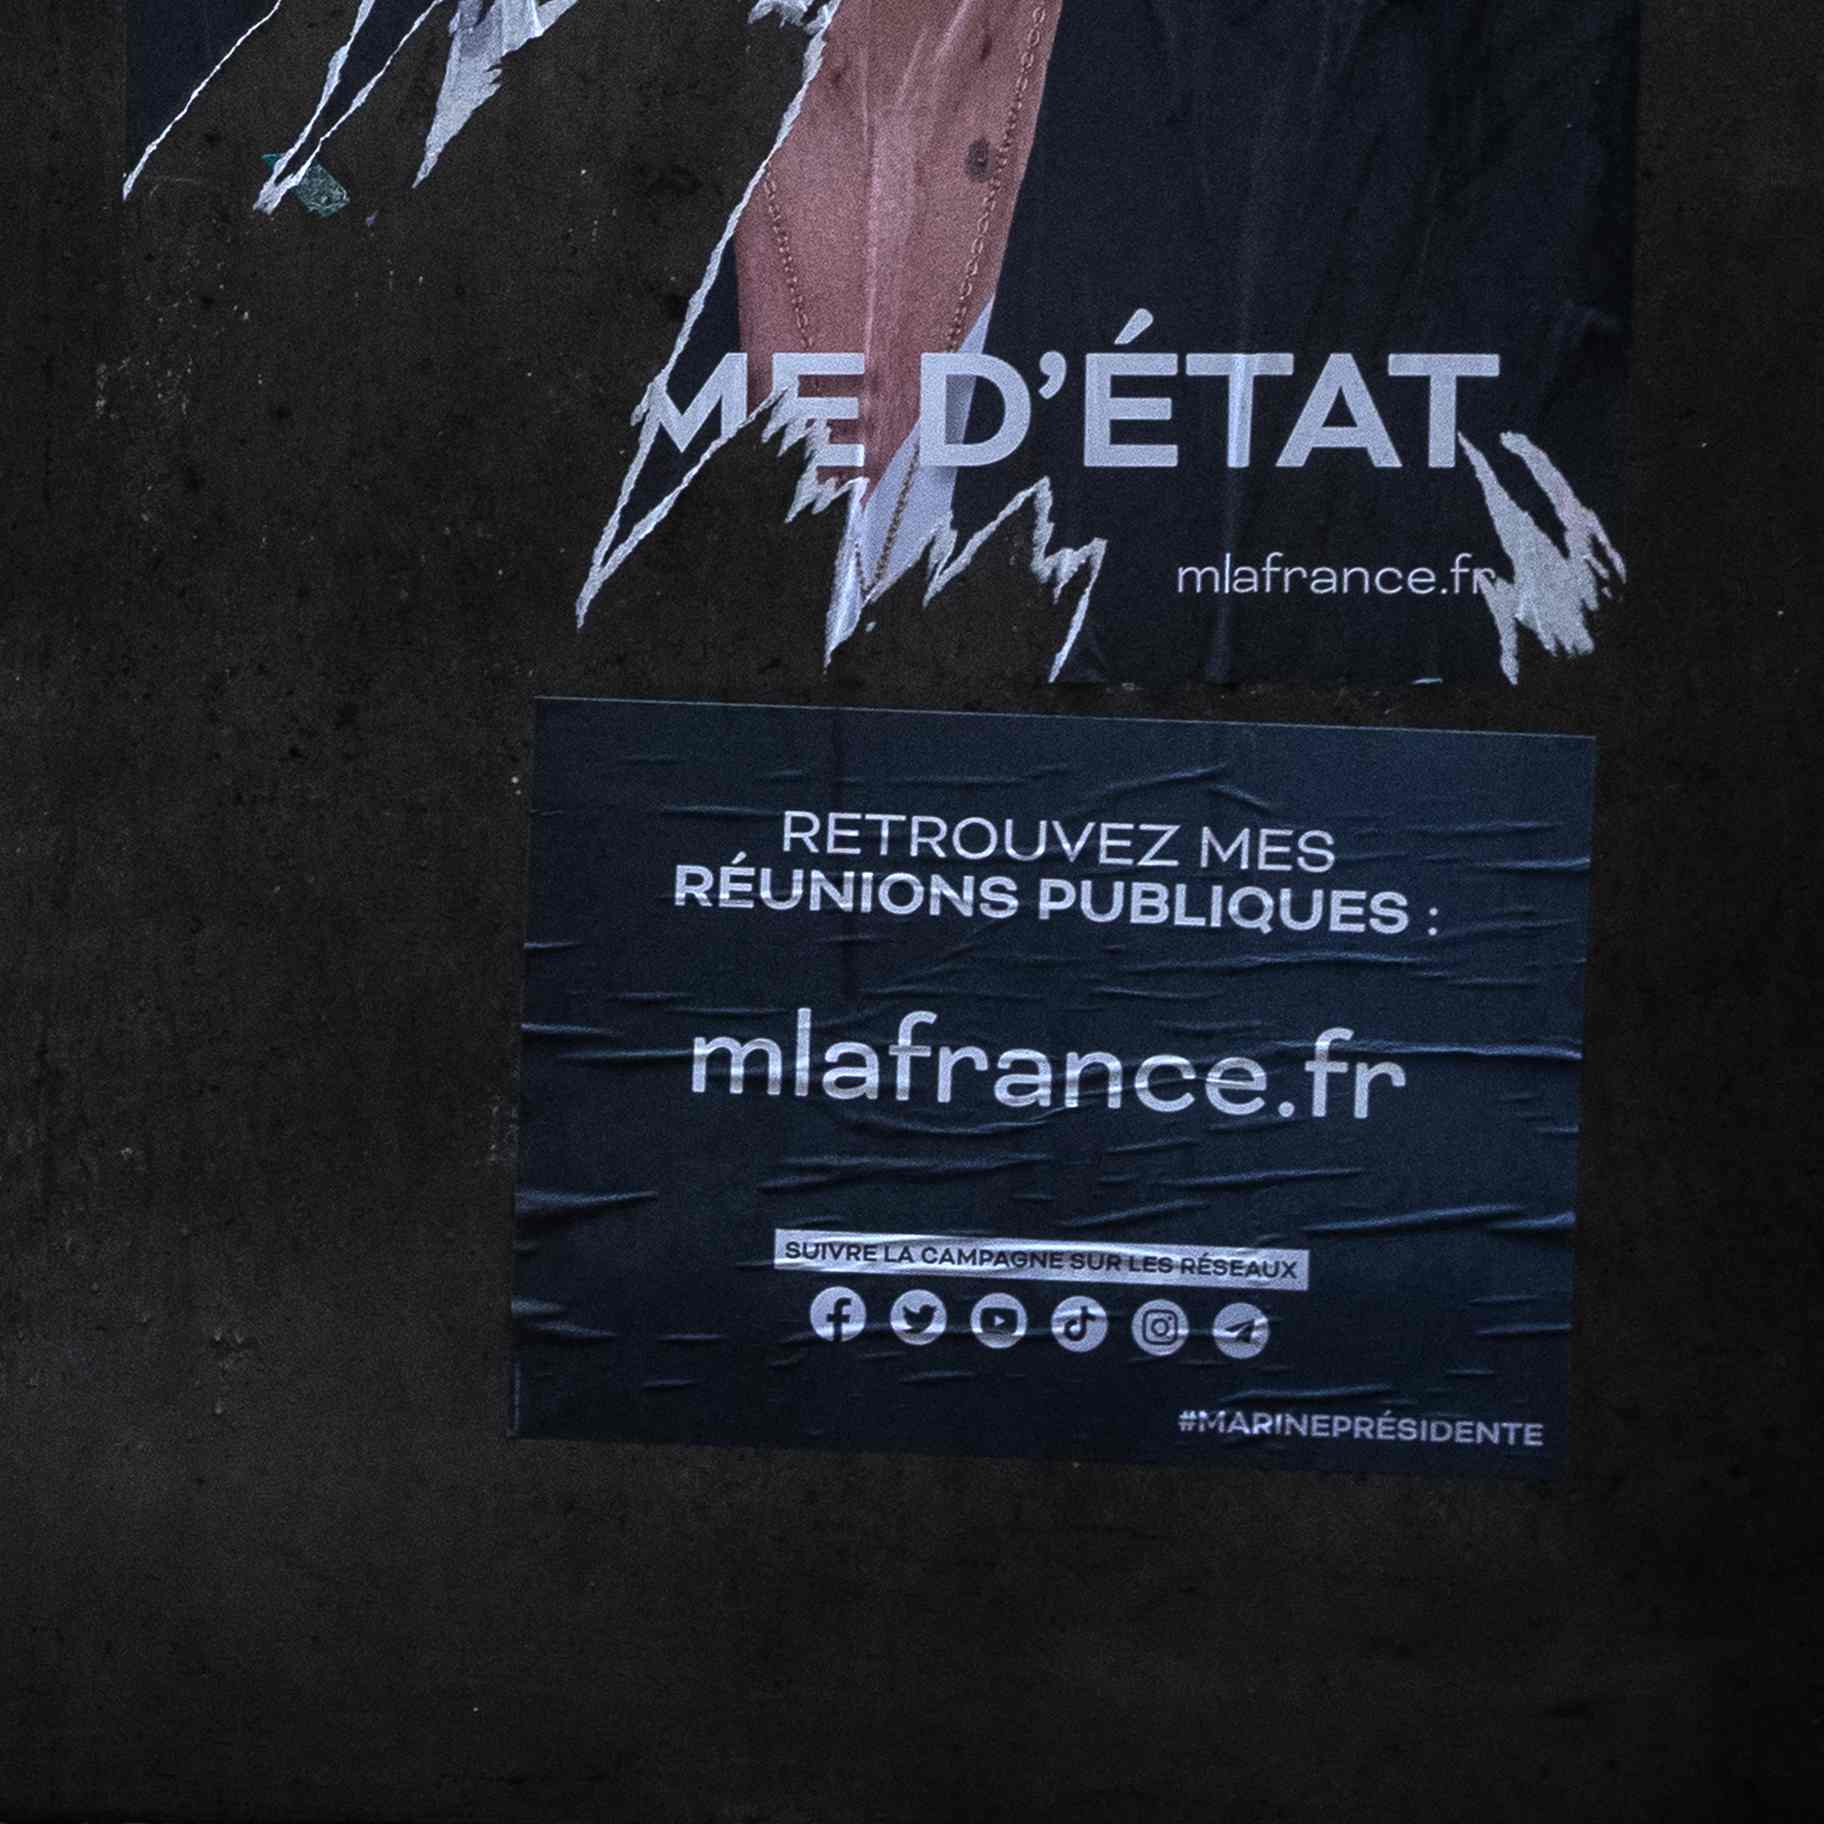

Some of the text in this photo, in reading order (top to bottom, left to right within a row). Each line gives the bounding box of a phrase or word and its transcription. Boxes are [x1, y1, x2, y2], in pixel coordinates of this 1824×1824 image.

[1176, 551, 1497, 595] mlafrance.fr
[783, 809, 1336, 874] RETROUVEZ MES
[674, 851, 1019, 919] RÉUNIONS
[1038, 877, 1410, 935] PUBLIQUES
[690, 1007, 1407, 1120] mlafrance.fr
[784, 1240, 1297, 1279] SUIVRE LA CAMPAGNE SUR LES RÉSEAUX
[1177, 1409, 1545, 1447] #MARINEPRÉSIDENTE
